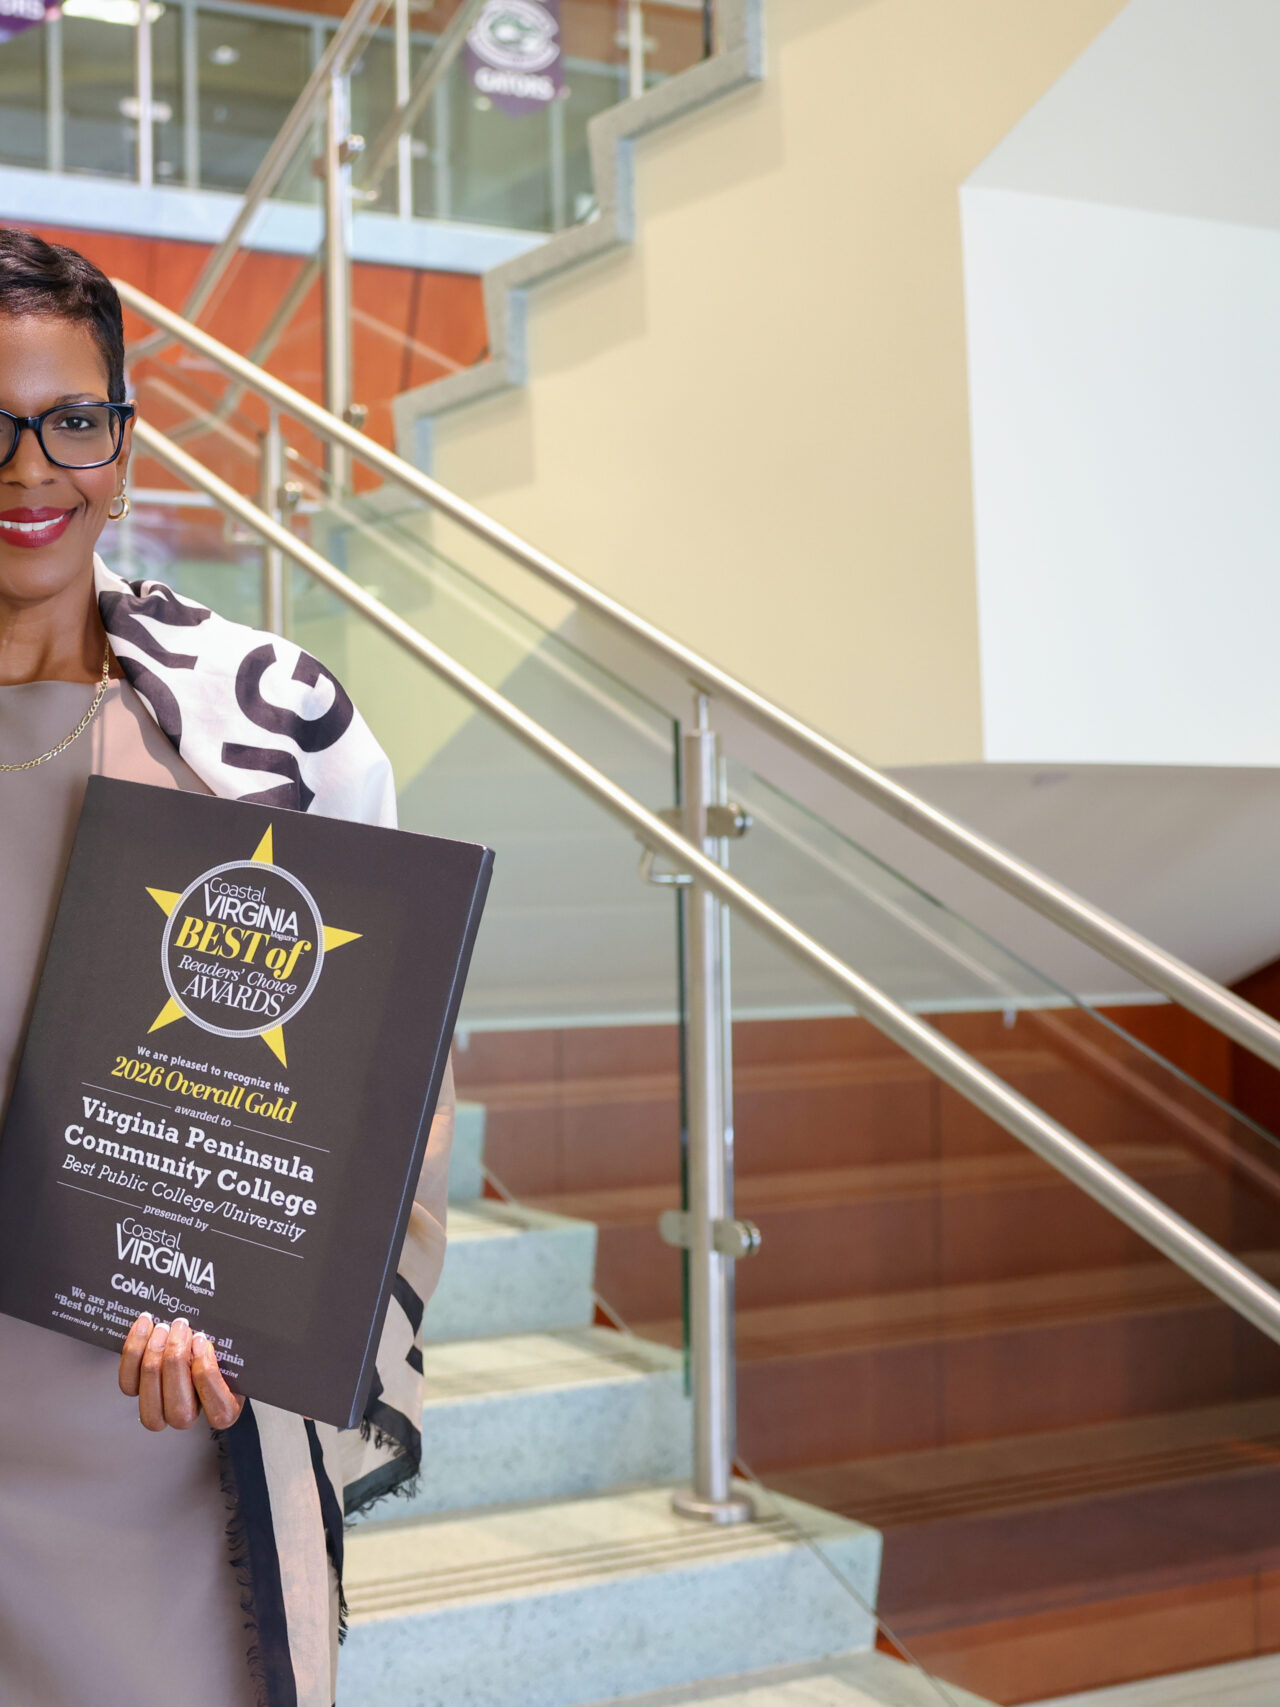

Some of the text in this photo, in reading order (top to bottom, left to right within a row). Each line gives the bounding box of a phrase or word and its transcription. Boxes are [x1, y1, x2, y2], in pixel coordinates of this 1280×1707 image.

[204, 882, 299, 937] VIRGINIA
[210, 877, 266, 903] Coastal
[174, 915, 312, 980] BEST of
[271, 931, 298, 942] Magazine
[181, 974, 285, 1018] AWARDS
[247, 971, 297, 995] Choice
[110, 1055, 298, 1124] 2026 Overall Gold
[137, 1045, 290, 1095] We are pleased to recognize the
[174, 1104, 232, 1127] awarded to
[82, 1096, 314, 1183] Virginia Peninsula
[64, 1124, 318, 1217] Community College
[62, 1154, 307, 1243] Best Public College/University
[143, 1204, 209, 1232] presented by
[116, 1222, 216, 1291] VIRGINIA
[122, 1217, 182, 1250] Coastal
[110, 1273, 200, 1316] CoVaMag.com
[185, 1281, 215, 1298] Magazine
[71, 1286, 86, 1300] We
[88, 1294, 106, 1306] are
[217, 1337, 233, 1350] all
